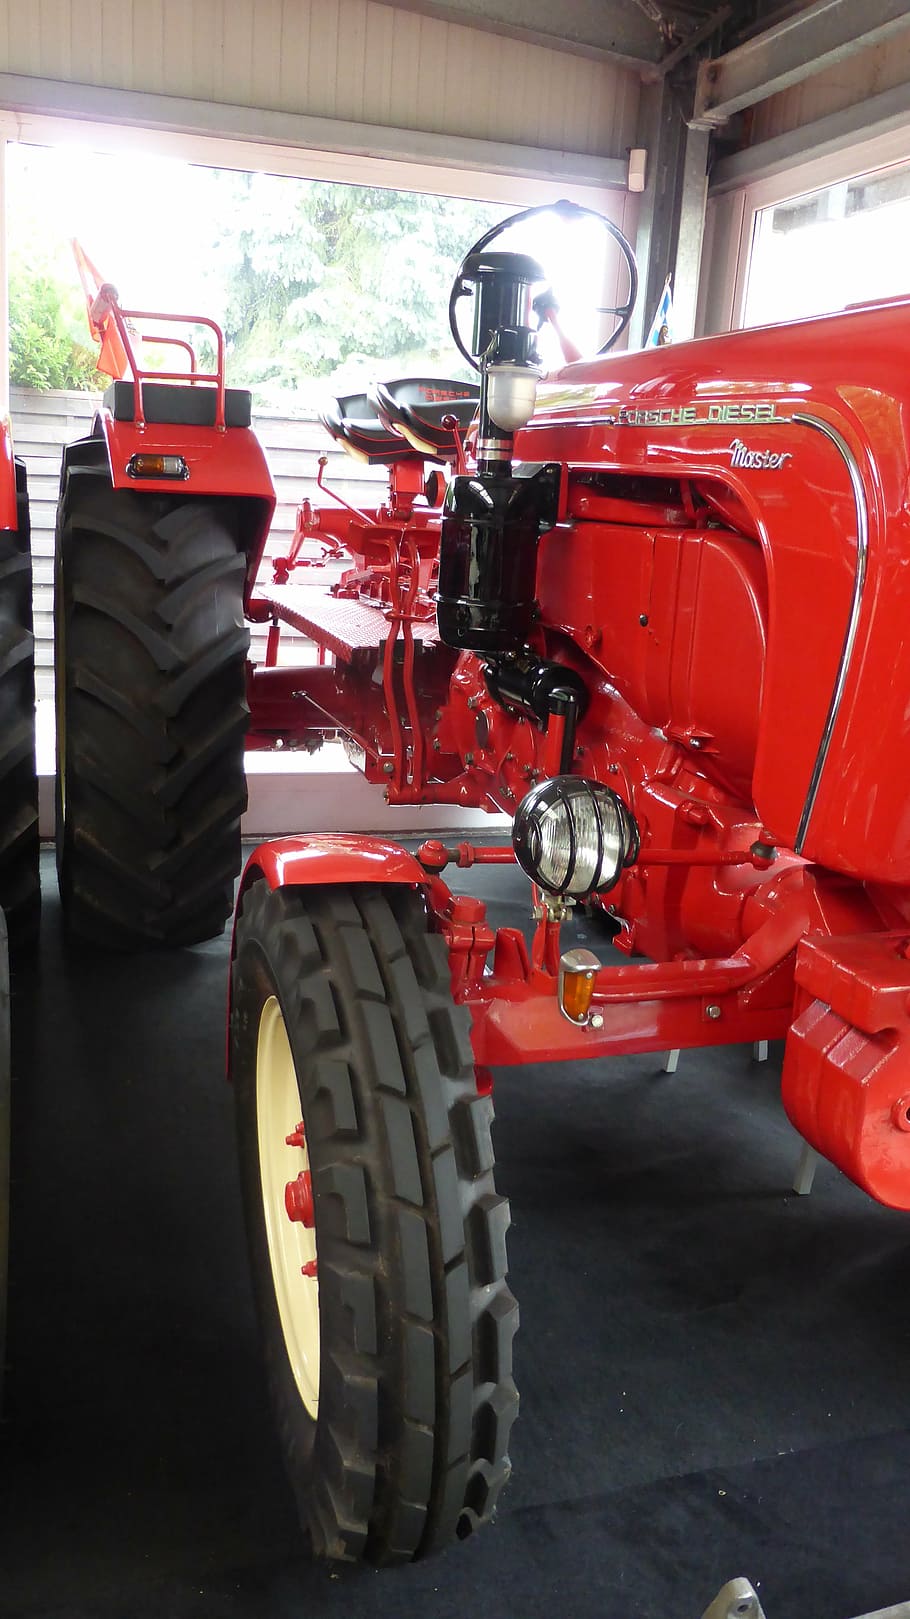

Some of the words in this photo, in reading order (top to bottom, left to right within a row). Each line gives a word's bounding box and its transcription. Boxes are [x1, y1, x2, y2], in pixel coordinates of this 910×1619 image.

[618, 407, 696, 424] PORSCHE
[708, 404, 778, 421] DIESEL
[729, 438, 792, 469] Master
